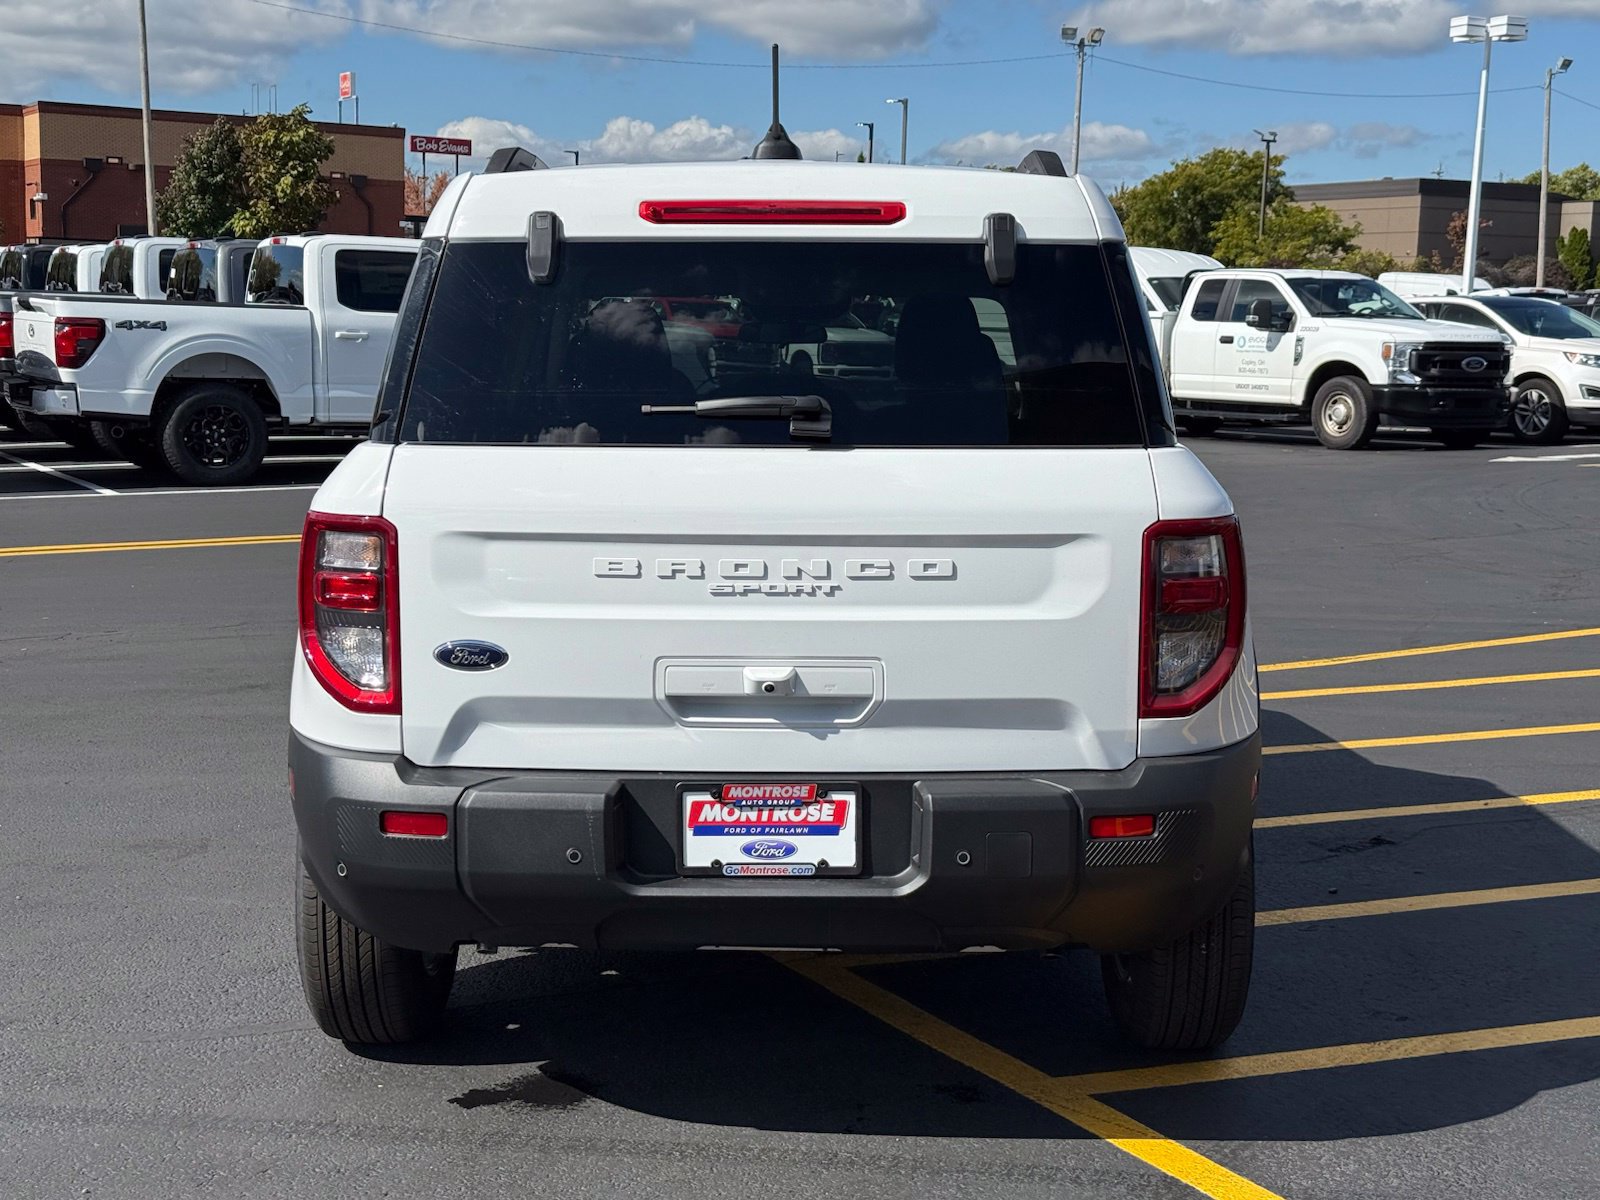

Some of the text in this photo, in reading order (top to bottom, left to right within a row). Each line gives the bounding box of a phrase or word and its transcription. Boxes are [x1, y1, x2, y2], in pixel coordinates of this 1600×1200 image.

[413, 137, 469, 154] Bob Evans
[592, 556, 958, 581] BRONCO
[707, 583, 843, 597] SPORT
[450, 646, 490, 664] Ford
[727, 785, 809, 799] MONTROSE
[698, 803, 836, 823] MONTROSE
[751, 841, 787, 857] Ford
[724, 865, 814, 875] GoMontrose.com
